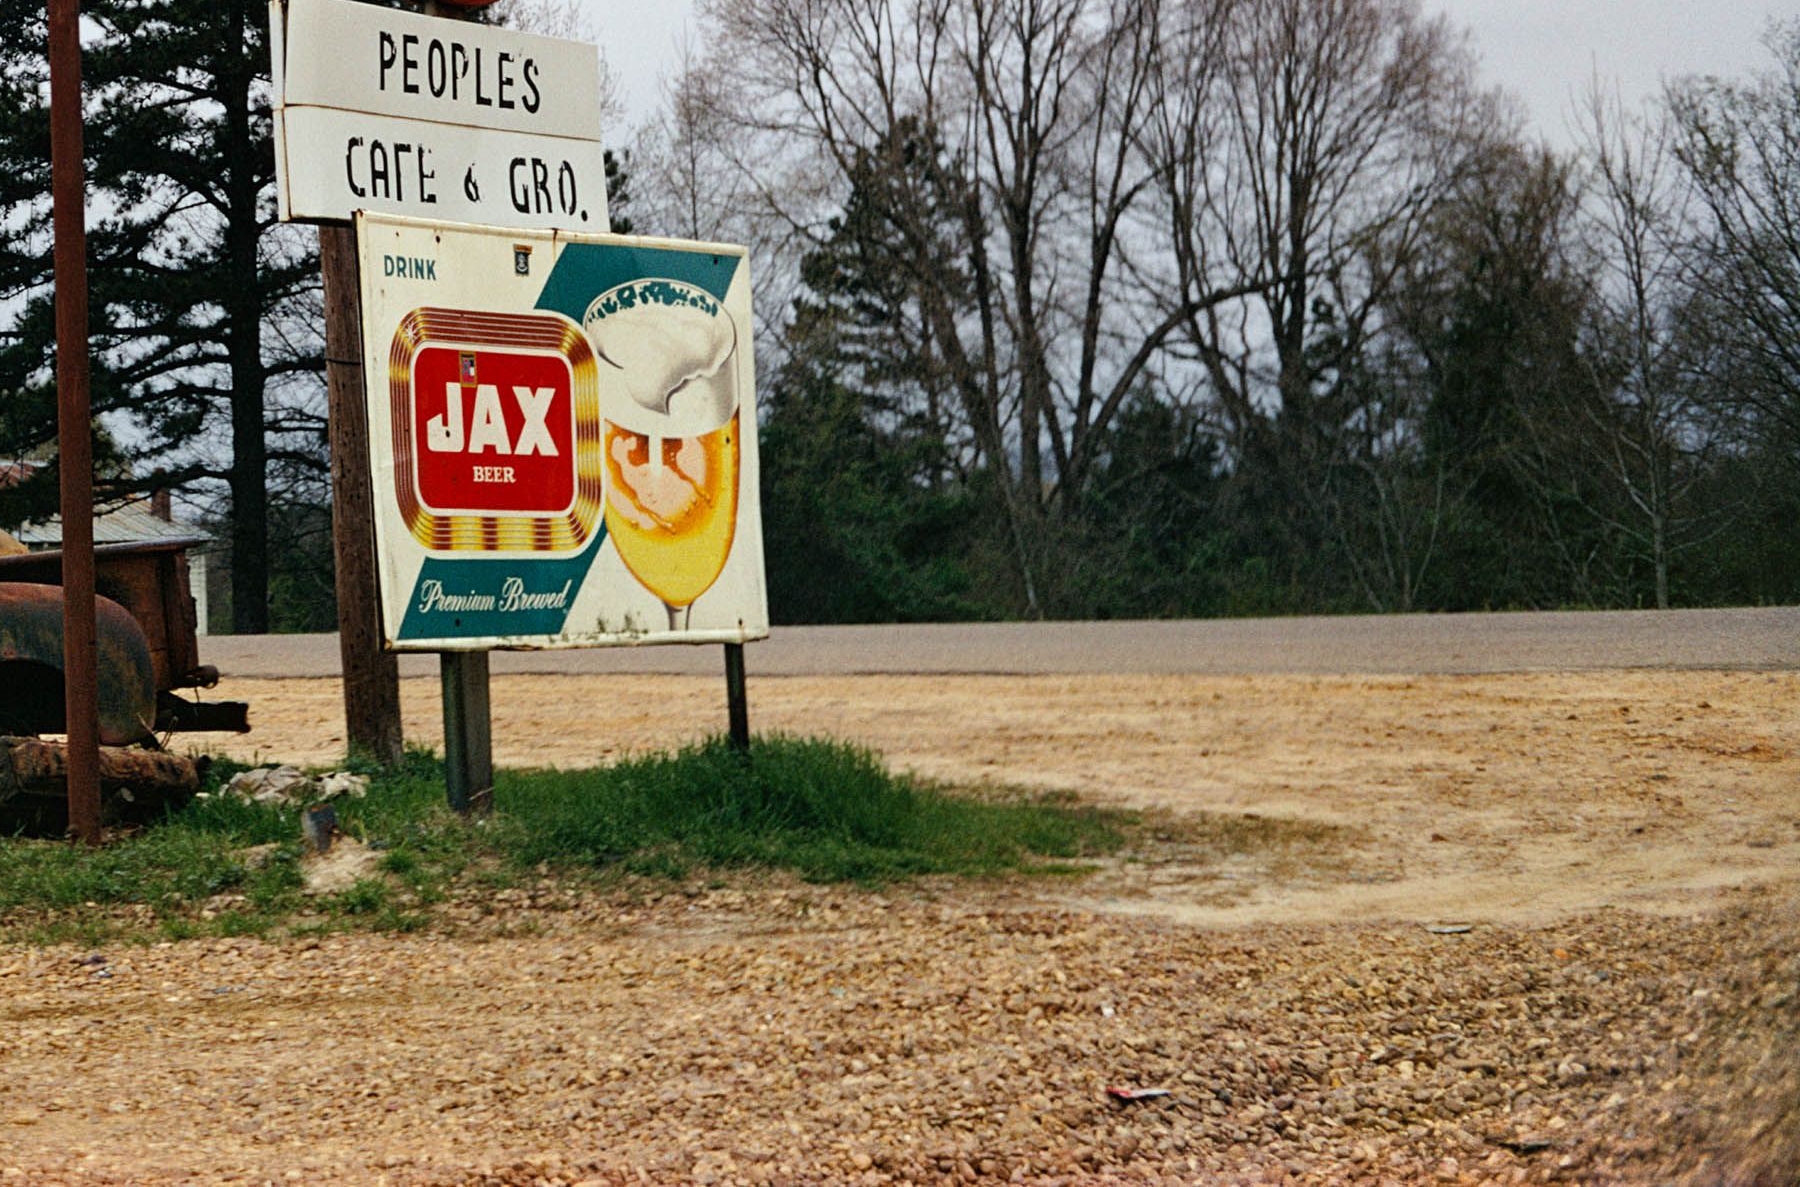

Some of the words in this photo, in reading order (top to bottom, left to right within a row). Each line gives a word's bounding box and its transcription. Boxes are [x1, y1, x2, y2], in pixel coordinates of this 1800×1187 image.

[508, 156, 589, 222] GRO.
[384, 254, 437, 281] DRINK
[426, 381, 560, 457] JAX
[472, 465, 517, 484] BEER
[419, 578, 496, 614] Premium
[498, 576, 573, 613] Brewed
